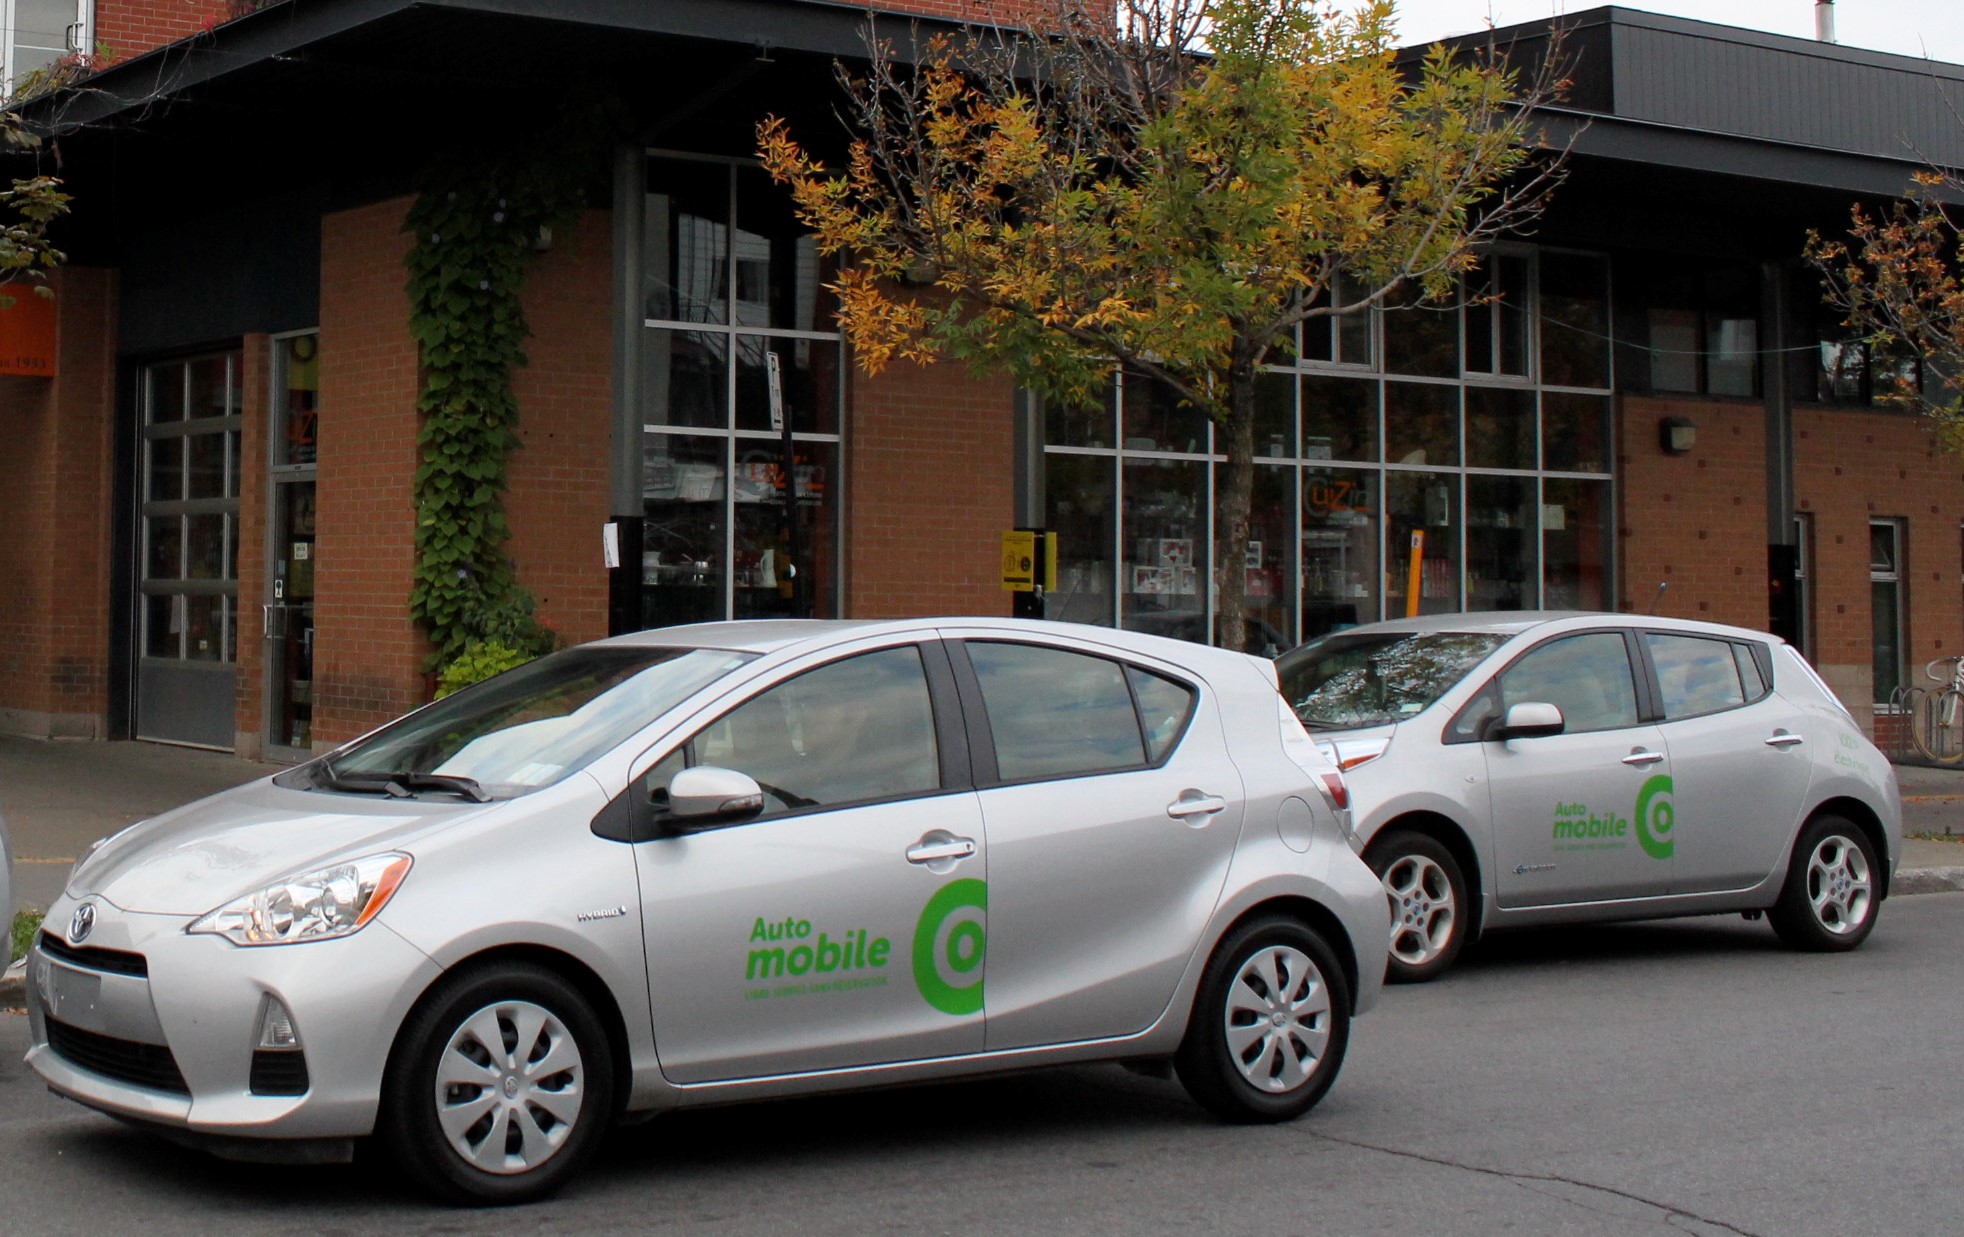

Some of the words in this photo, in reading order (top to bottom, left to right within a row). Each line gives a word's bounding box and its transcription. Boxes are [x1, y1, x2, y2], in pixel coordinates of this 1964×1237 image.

[1554, 802, 1586, 816] Auto
[1553, 812, 1628, 839] mobile
[577, 908, 619, 922] HYBRID
[749, 917, 812, 942] Auto
[745, 929, 892, 980] mobile
